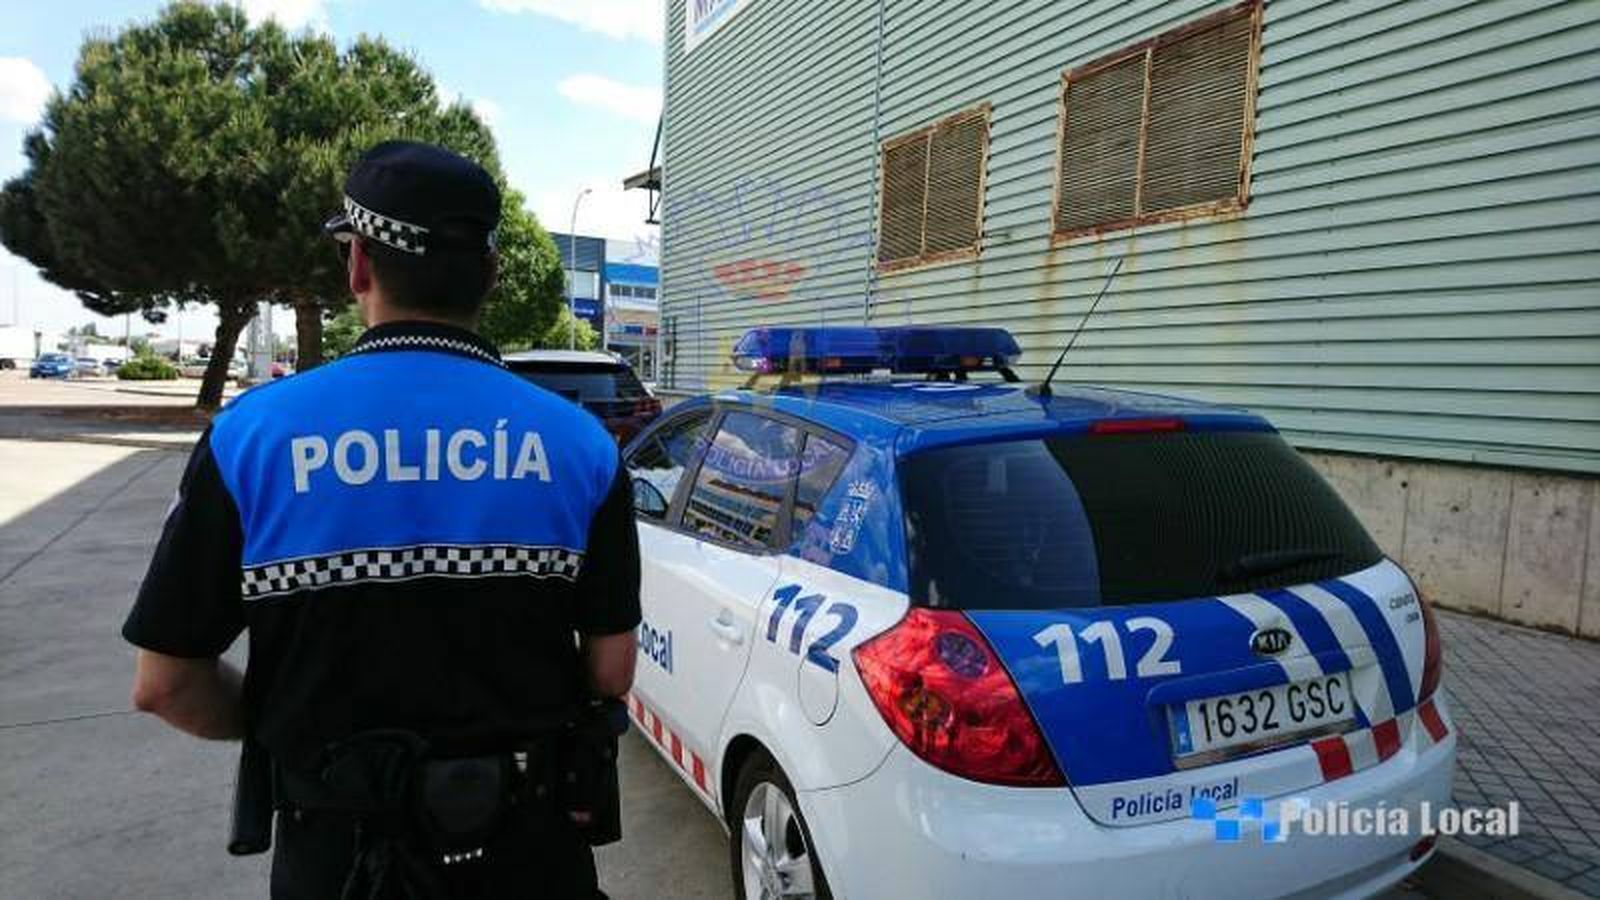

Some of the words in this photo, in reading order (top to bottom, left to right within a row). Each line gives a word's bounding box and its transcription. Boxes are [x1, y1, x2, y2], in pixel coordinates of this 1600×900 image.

[291, 418, 552, 493] POLICÍA
[637, 621, 673, 674] ocal
[765, 583, 859, 673] 112
[1033, 616, 1182, 685] 112
[1199, 690, 1280, 742] 1632
[1287, 678, 1345, 723] GSC
[1112, 789, 1183, 819] Policía
